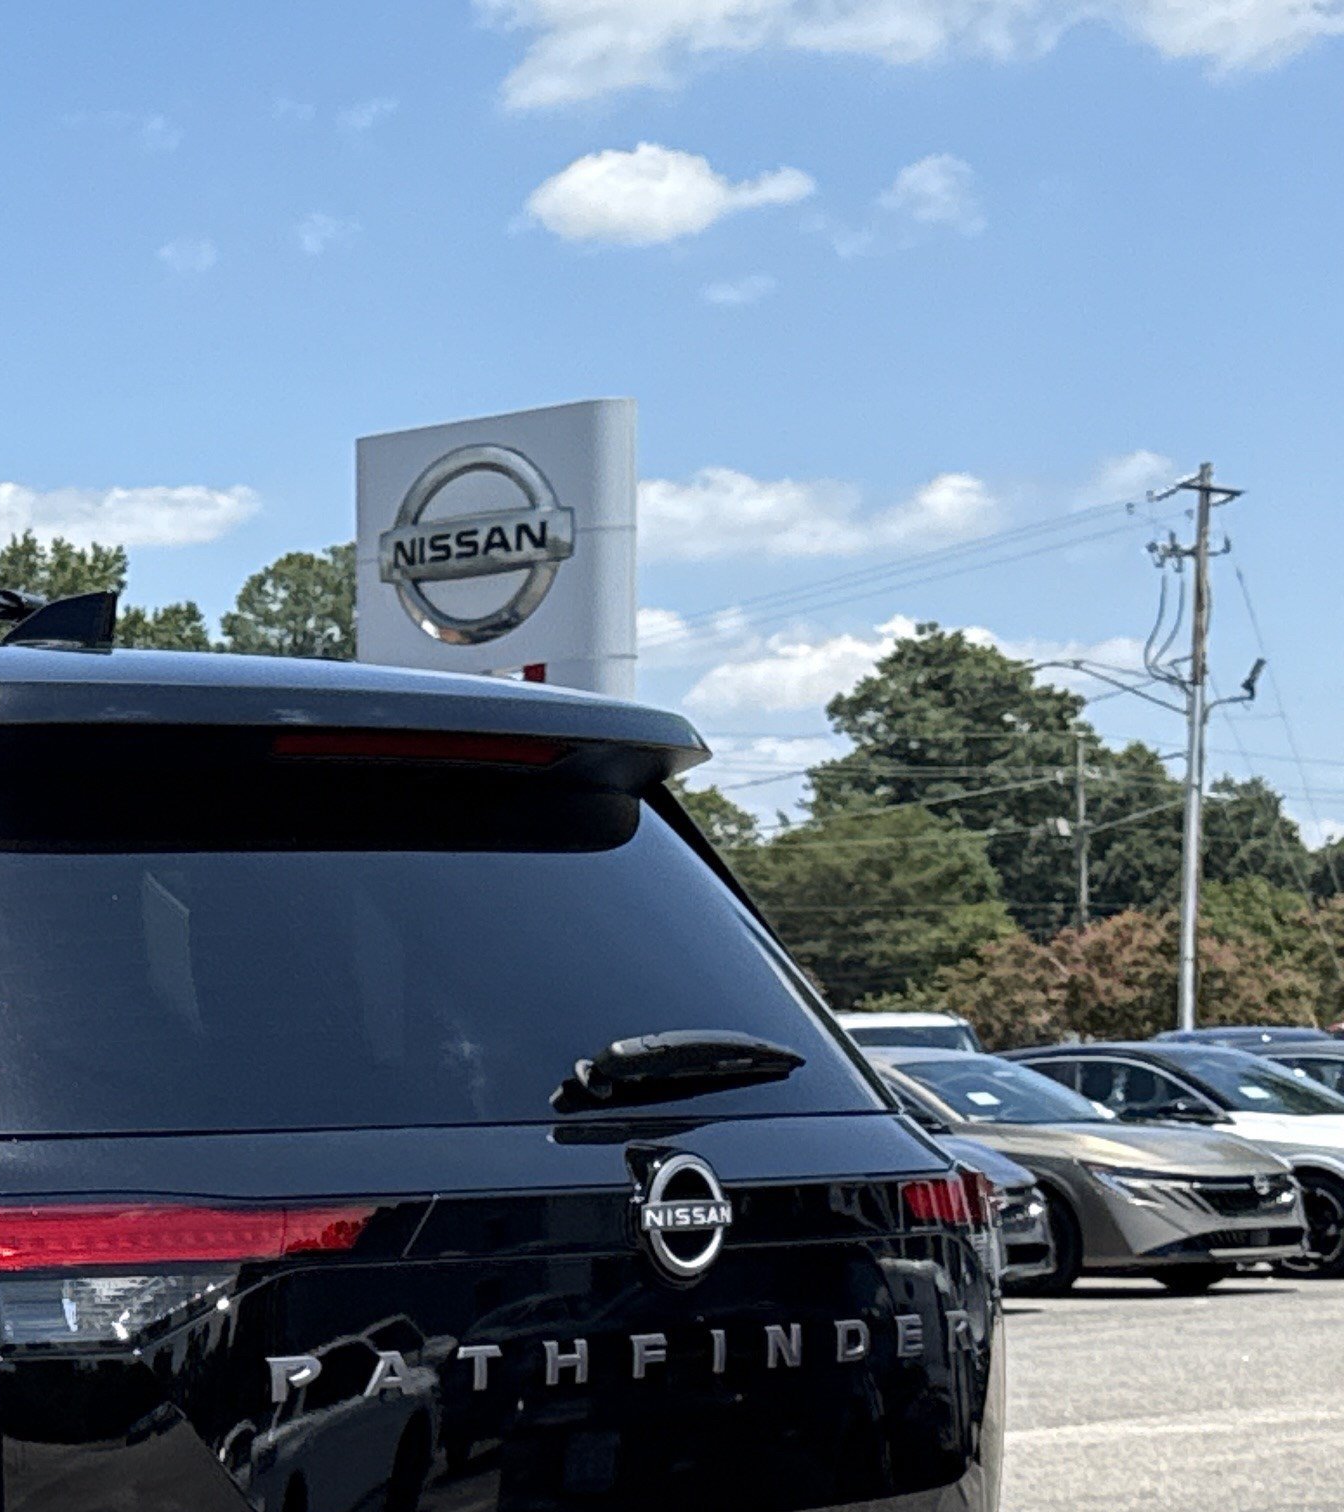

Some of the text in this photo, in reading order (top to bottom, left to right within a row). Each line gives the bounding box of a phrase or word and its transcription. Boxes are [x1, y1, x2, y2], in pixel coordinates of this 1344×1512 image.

[393, 521, 547, 569] NISSAN
[644, 1206, 732, 1227] NISSAN
[264, 1309, 975, 1403] PATHFINDER
